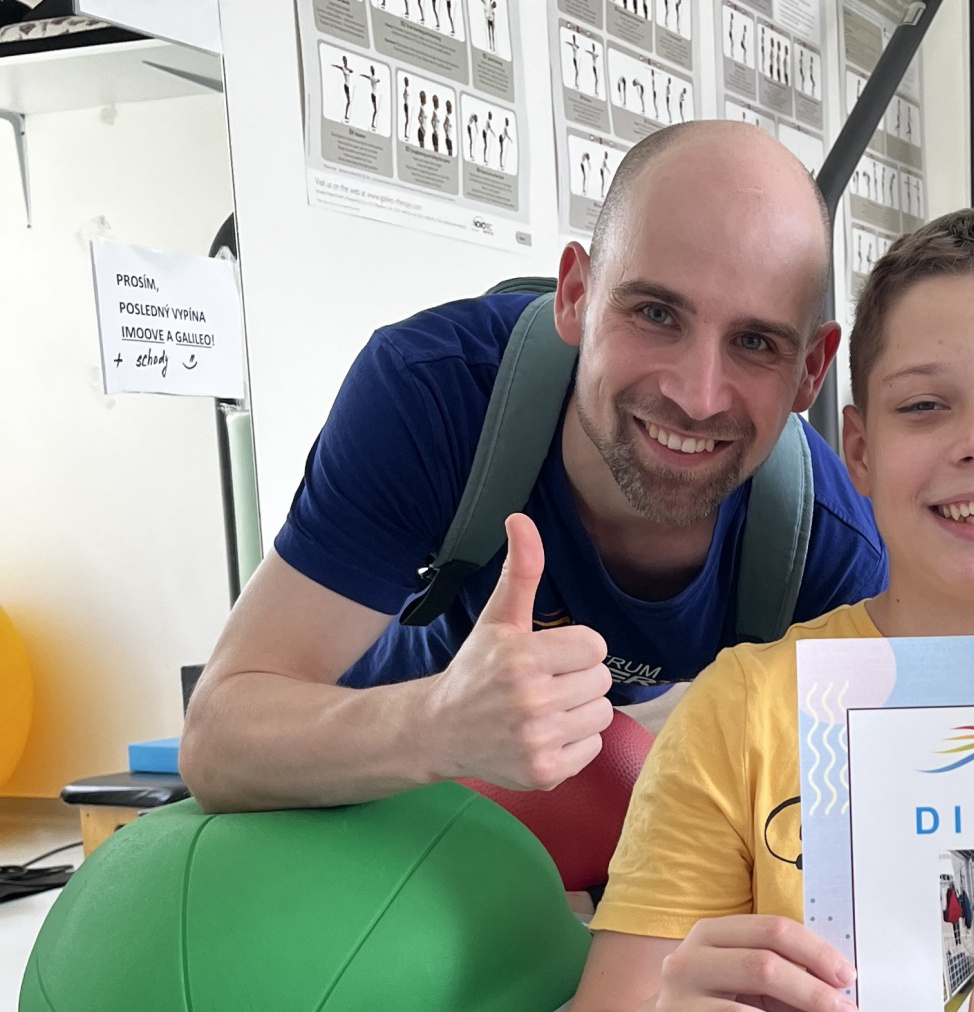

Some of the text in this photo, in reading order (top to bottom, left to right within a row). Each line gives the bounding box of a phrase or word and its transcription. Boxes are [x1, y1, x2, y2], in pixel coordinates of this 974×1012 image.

[116, 274, 159, 292] PROSÍM,
[119, 302, 206, 323] POSLEDNÝ VYPÍNA
[121, 326, 215, 347] IMOOVE A GALILEO!
[135, 348, 169, 378] schody
